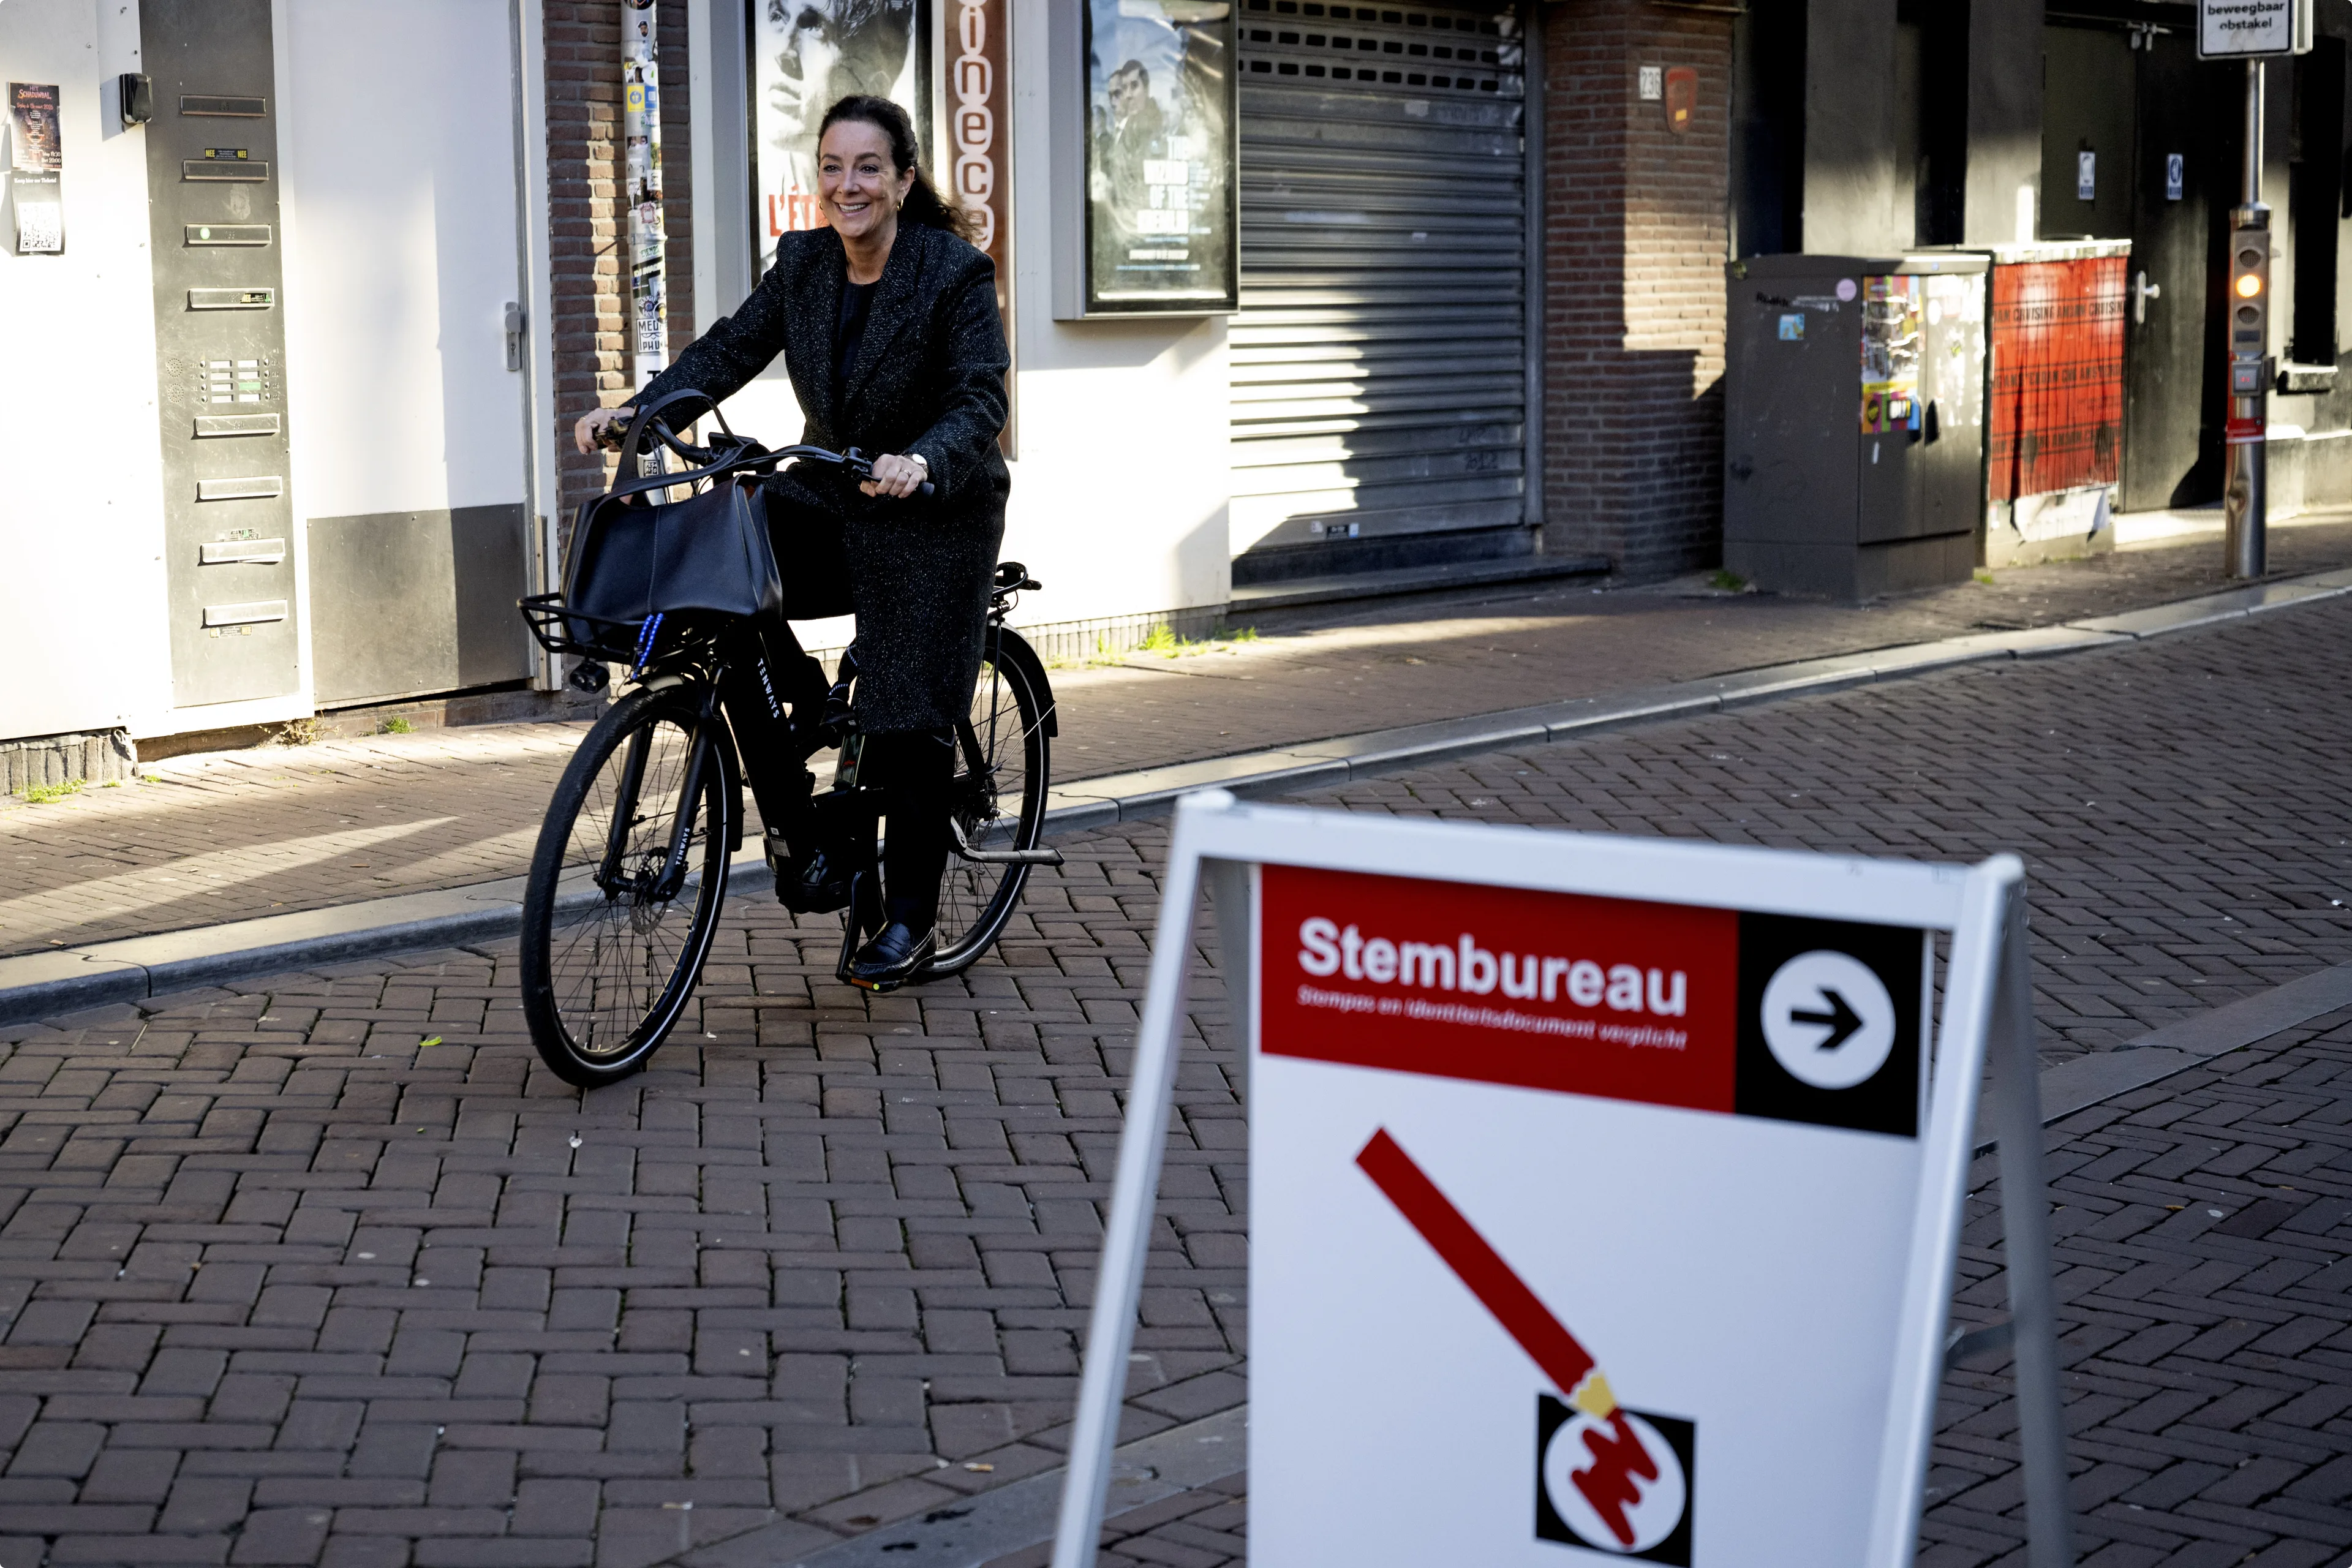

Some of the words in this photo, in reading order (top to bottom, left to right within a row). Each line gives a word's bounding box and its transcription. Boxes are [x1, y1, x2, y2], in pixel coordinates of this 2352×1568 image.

[2207, 2, 2285, 16] beweegbaar
[2219, 17, 2272, 30] obstakel
[1642, 72, 1661, 95] 236
[237, 150, 247, 159] NEE
[758, 658, 780, 718] TENWAYS
[675, 827, 690, 865] TENWAYS
[1297, 915, 1687, 1017] Stembureau
[1377, 997, 1403, 1016] en
